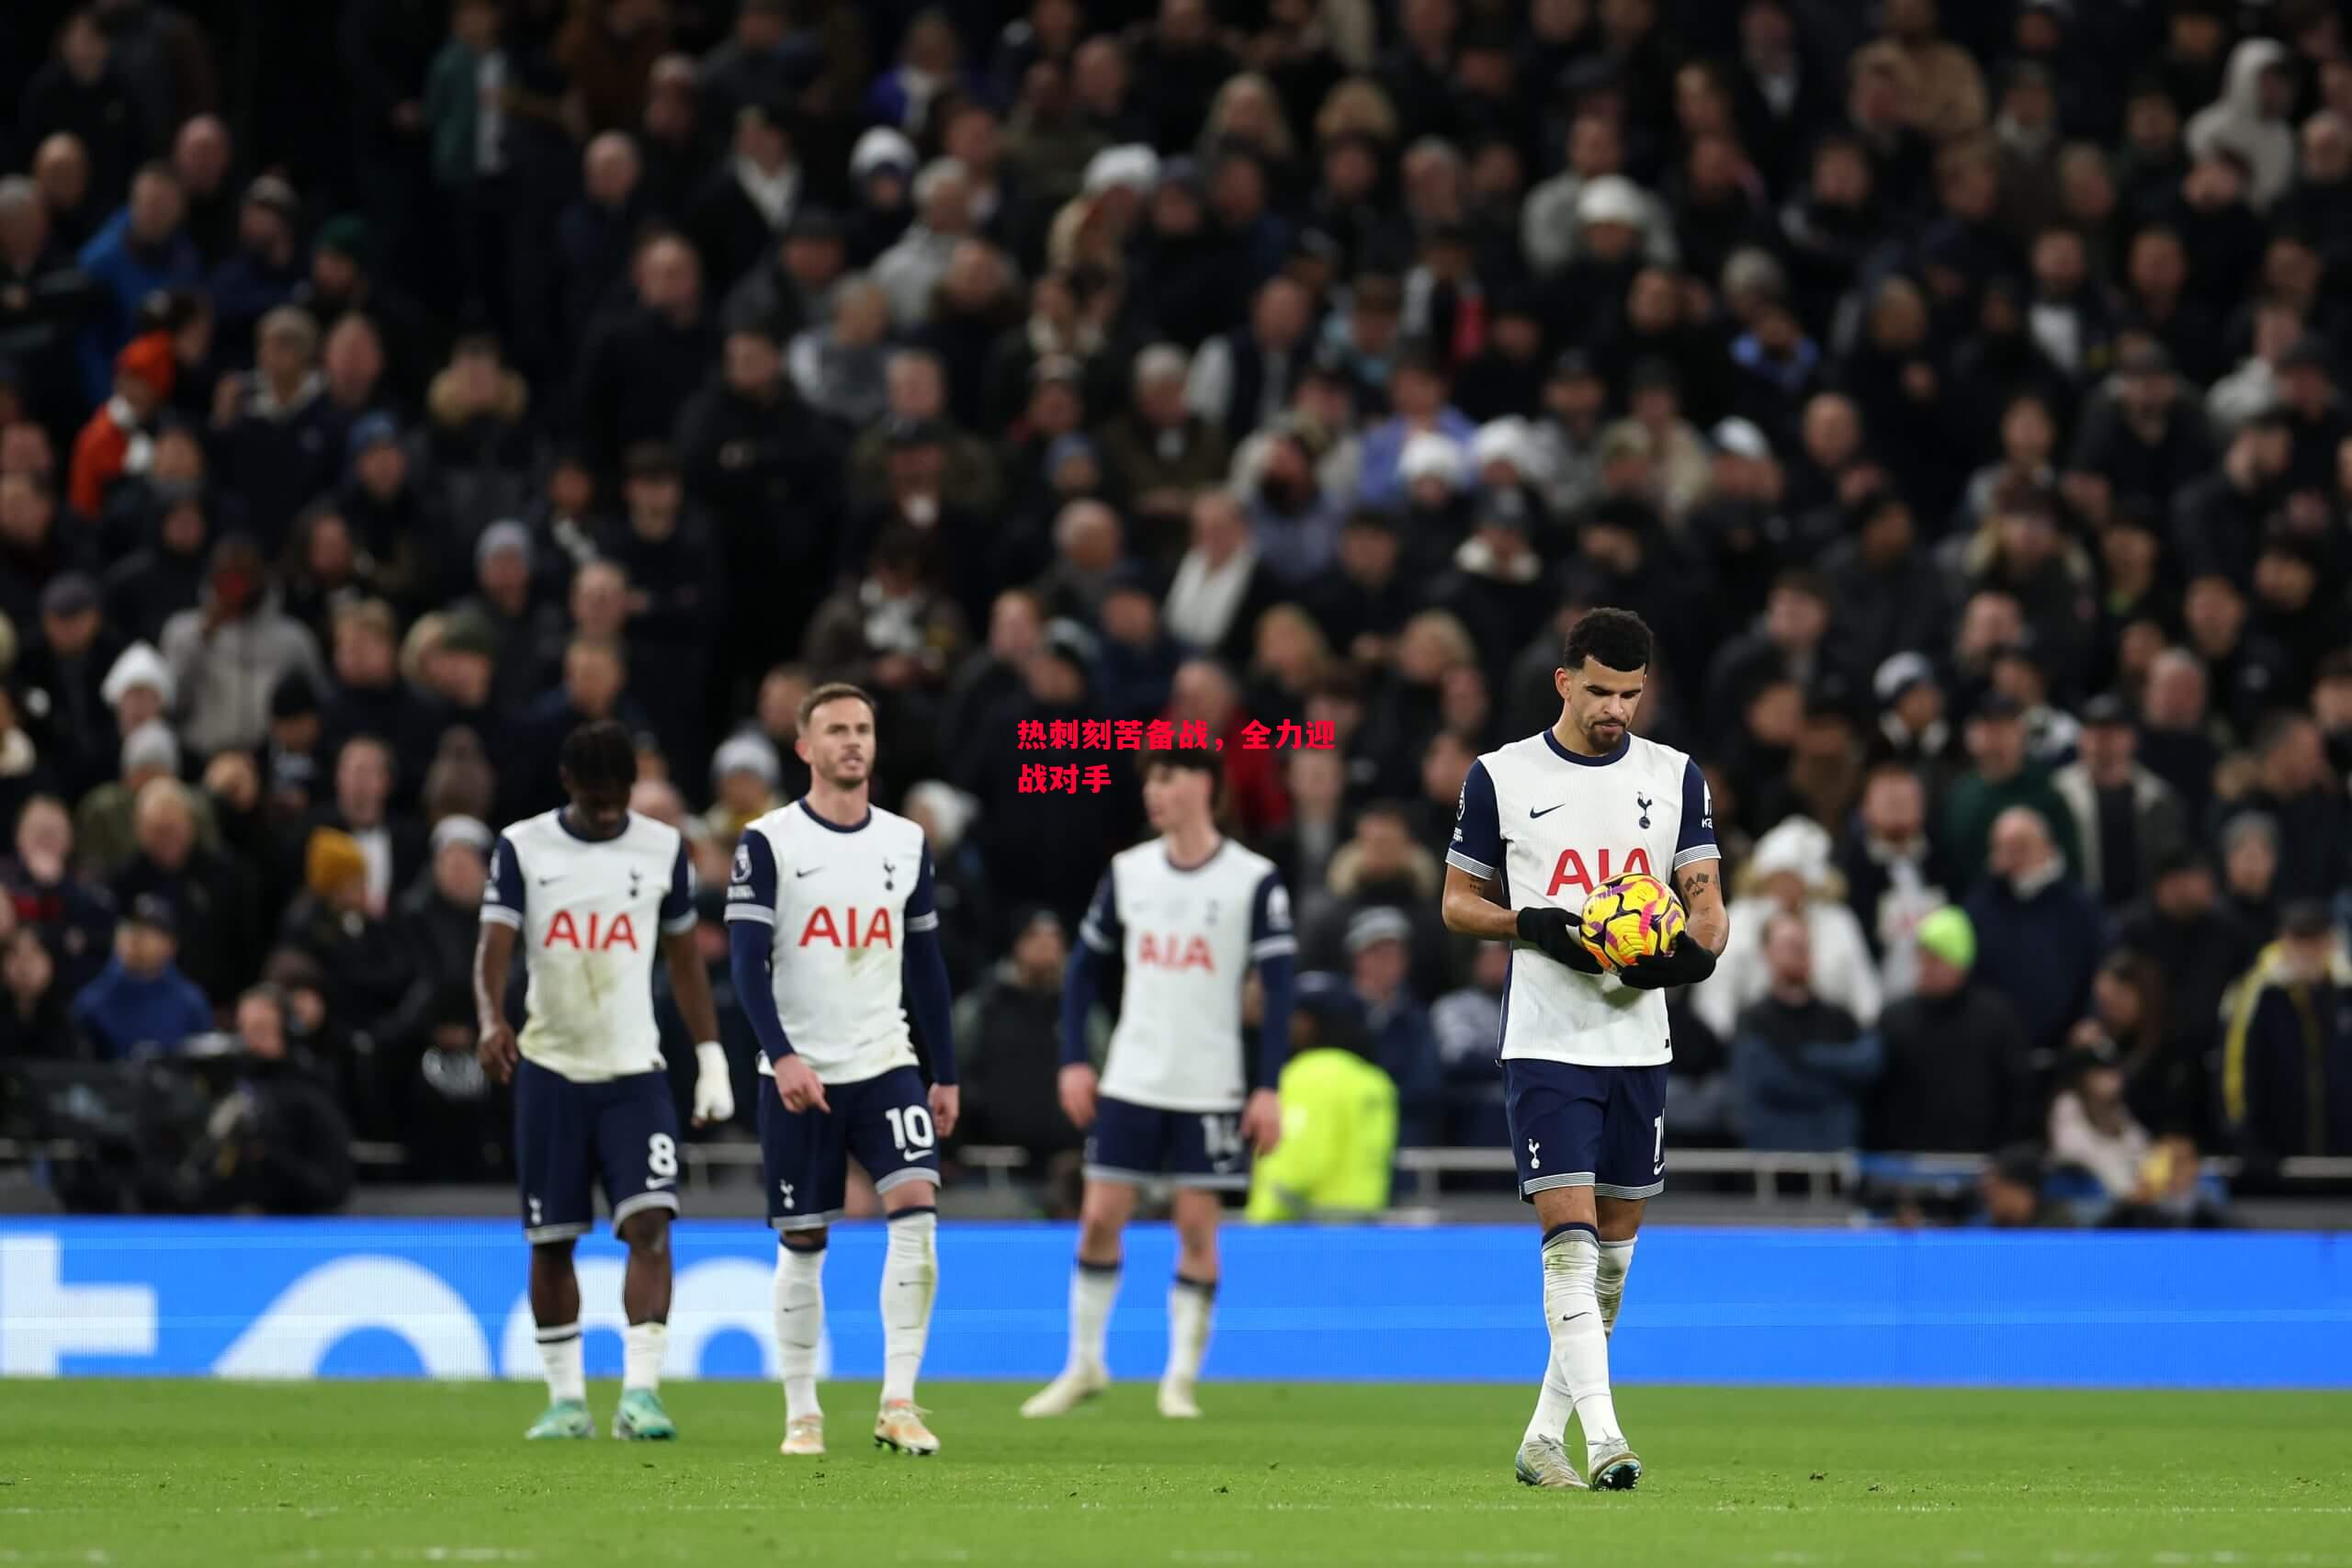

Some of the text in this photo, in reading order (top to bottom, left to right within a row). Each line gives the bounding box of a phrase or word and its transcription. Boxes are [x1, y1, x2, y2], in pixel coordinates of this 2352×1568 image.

[543, 910, 638, 952] AIA
[798, 906, 893, 949] AIA
[1138, 931, 1215, 973] AIA
[886, 1105, 935, 1149] 10
[1655, 1108, 1665, 1163] 1
[648, 1132, 678, 1177] 8
